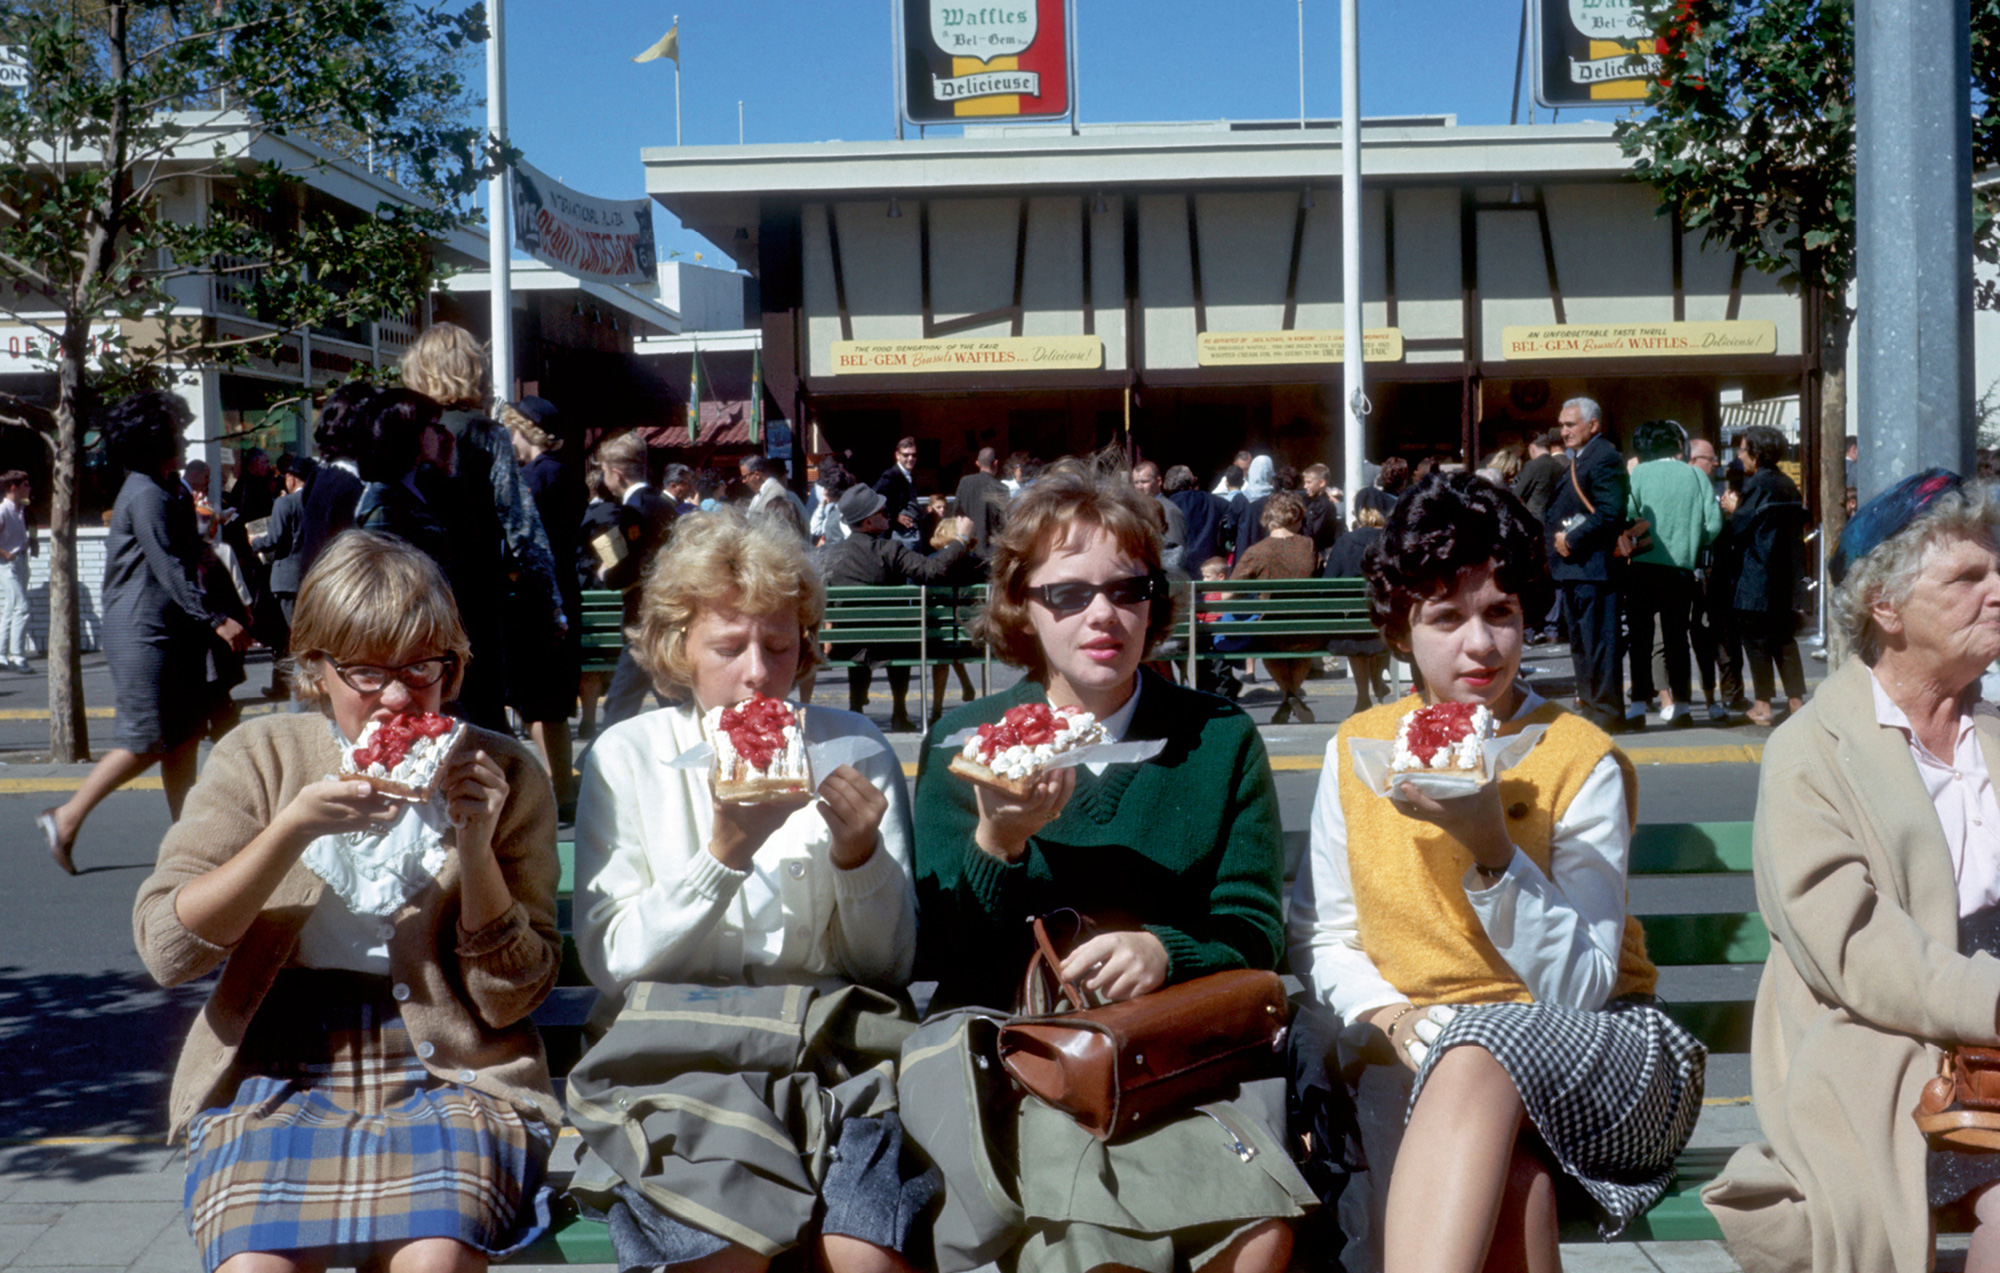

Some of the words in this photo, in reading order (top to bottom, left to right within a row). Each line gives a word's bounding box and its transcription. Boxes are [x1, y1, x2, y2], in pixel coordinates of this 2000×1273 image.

[941, 7, 1028, 27] Waffles
[952, 33, 1016, 47] Bel-Gem
[941, 75, 1030, 97] Delicieuse
[1543, 329, 1609, 338] UNFORGETTABLE
[1613, 328, 1637, 336] TASTE
[1639, 328, 1667, 336] THRILL
[9, 336, 34, 359] OF
[855, 345, 870, 353] THE
[895, 344, 942, 352] SENSATION
[978, 342, 999, 350] FAIR
[1582, 338, 1624, 353] Brussels
[912, 350, 953, 367] Brussels
